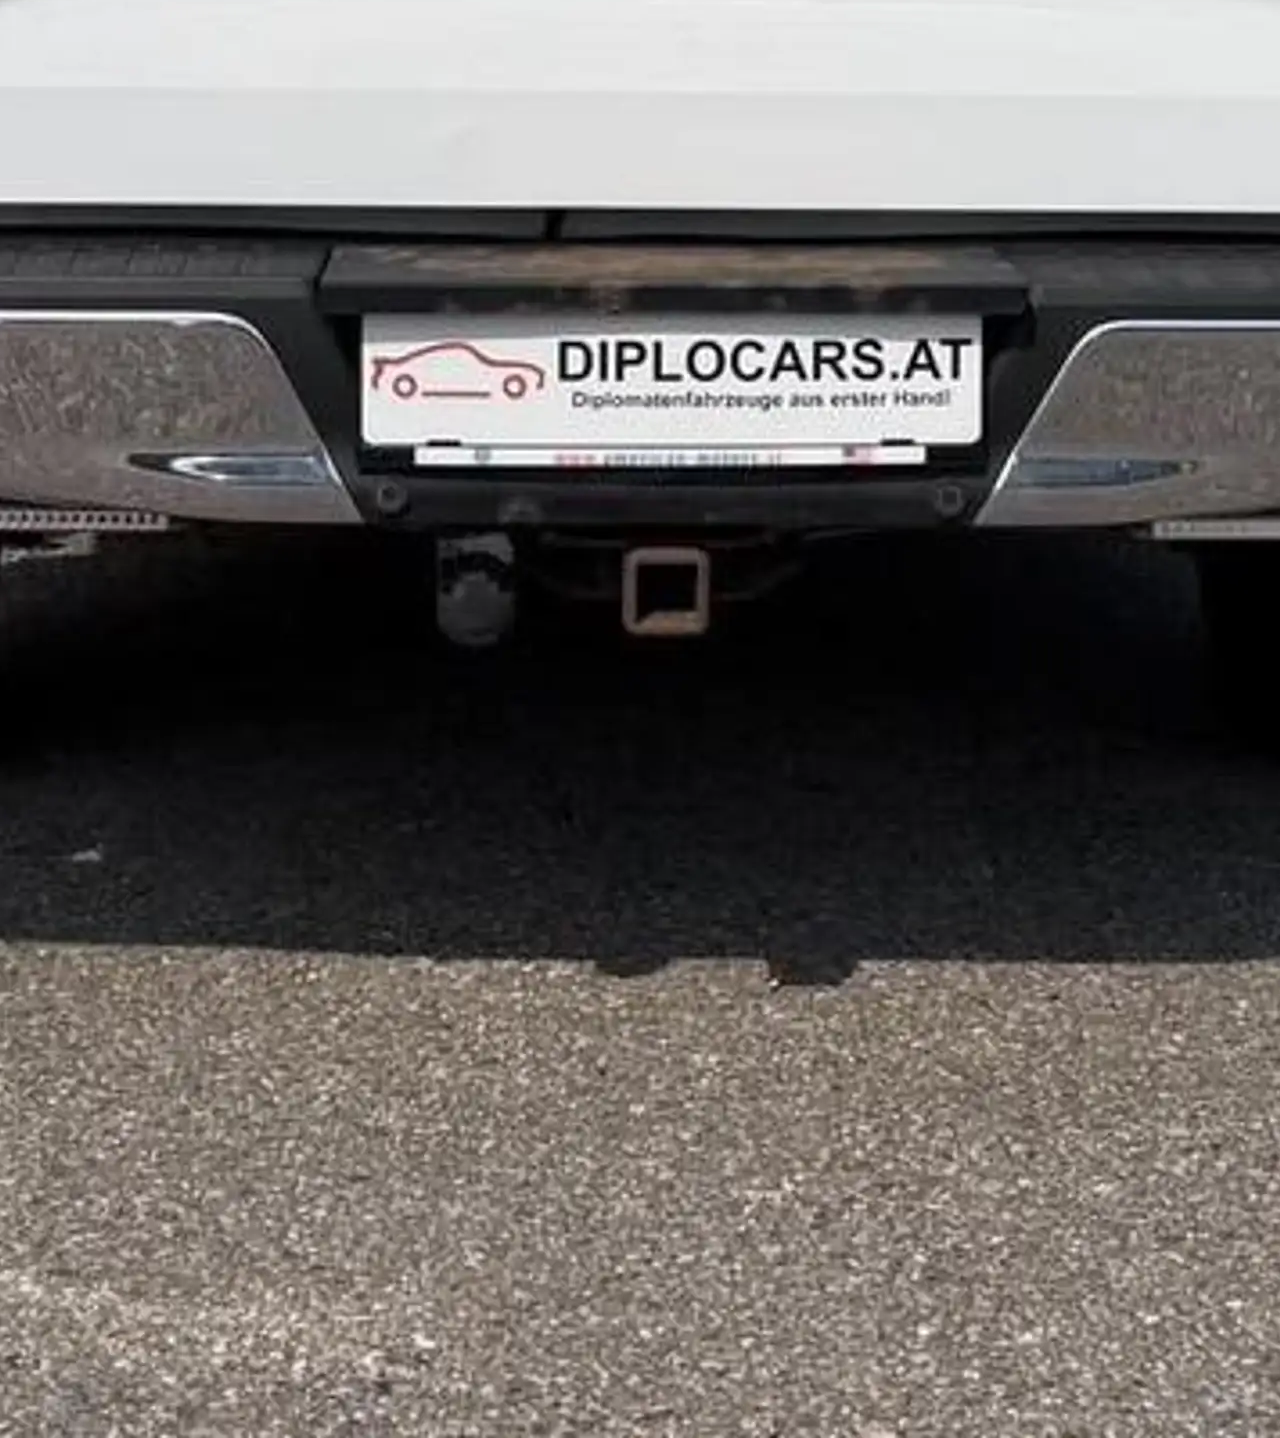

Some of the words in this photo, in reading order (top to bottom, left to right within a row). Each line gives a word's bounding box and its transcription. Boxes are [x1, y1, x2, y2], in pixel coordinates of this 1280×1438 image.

[558, 338, 973, 382] DIPLOCARS.AT
[572, 390, 783, 411] Diplomatenfahrzeuge
[789, 393, 824, 408] aus
[830, 391, 887, 408] erster
